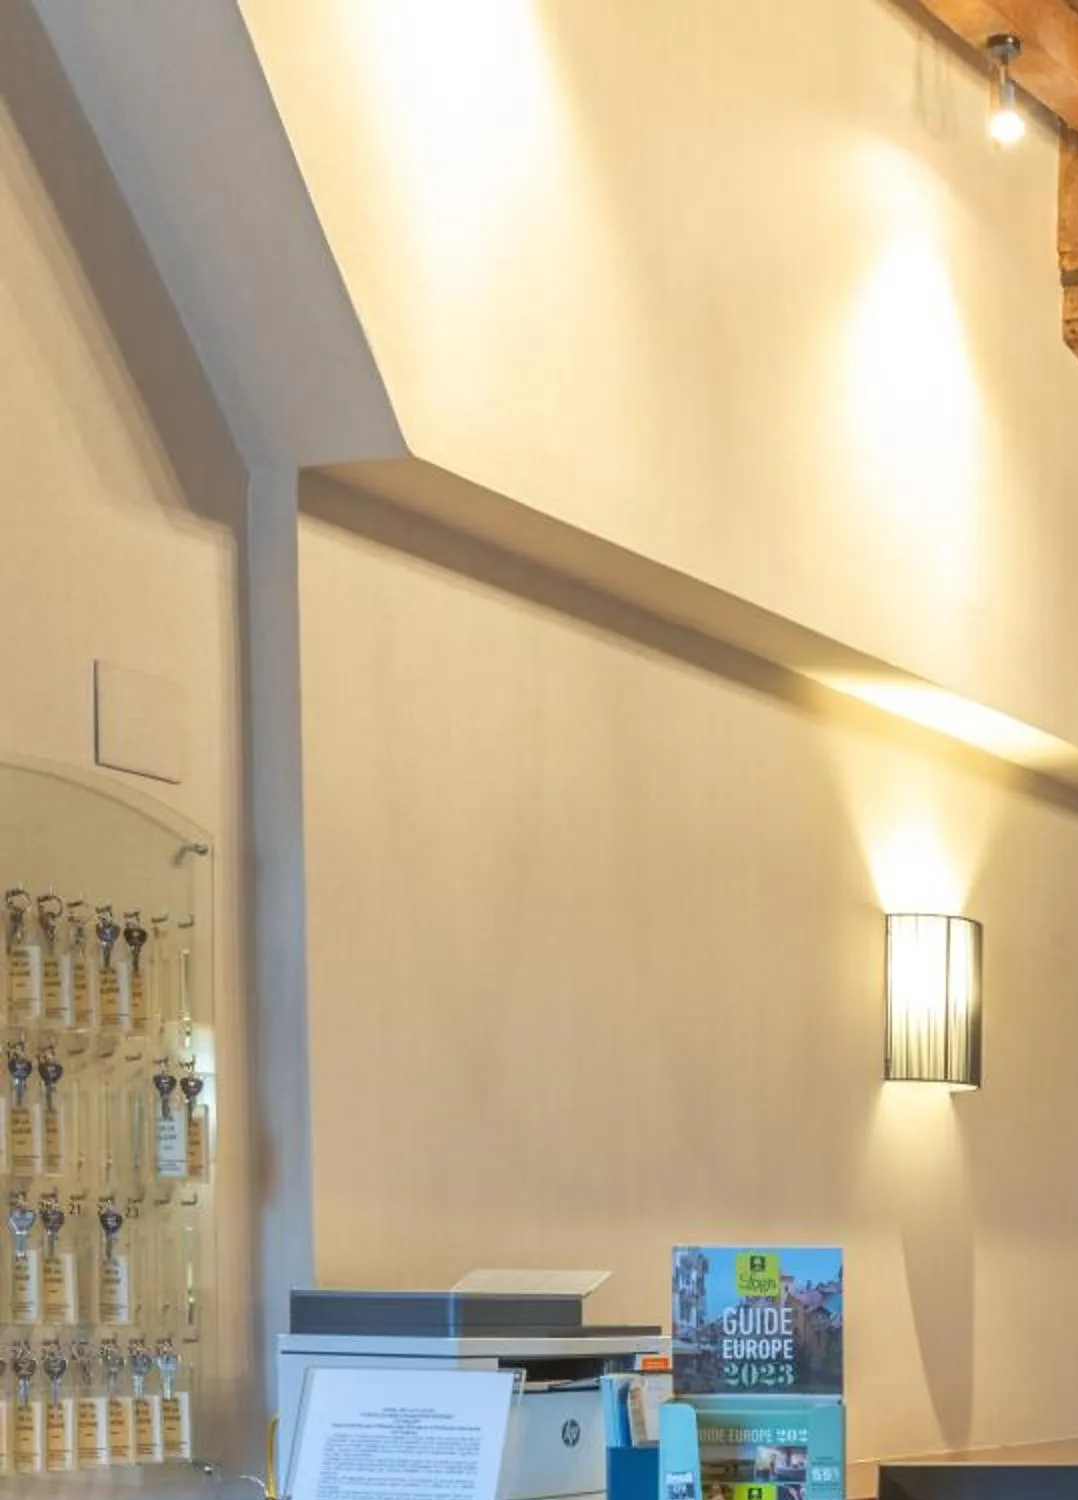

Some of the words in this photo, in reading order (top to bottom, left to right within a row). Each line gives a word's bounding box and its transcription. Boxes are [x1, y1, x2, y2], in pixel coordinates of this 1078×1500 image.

[69, 1203, 81, 1215] 21
[722, 1306, 793, 1335] GUIDE
[722, 1339, 793, 1360] EUROPE
[723, 1363, 795, 1386] 2023
[699, 1427, 724, 1442] UIDE
[729, 1427, 772, 1443] EUROPE
[775, 1427, 809, 1444] 202
